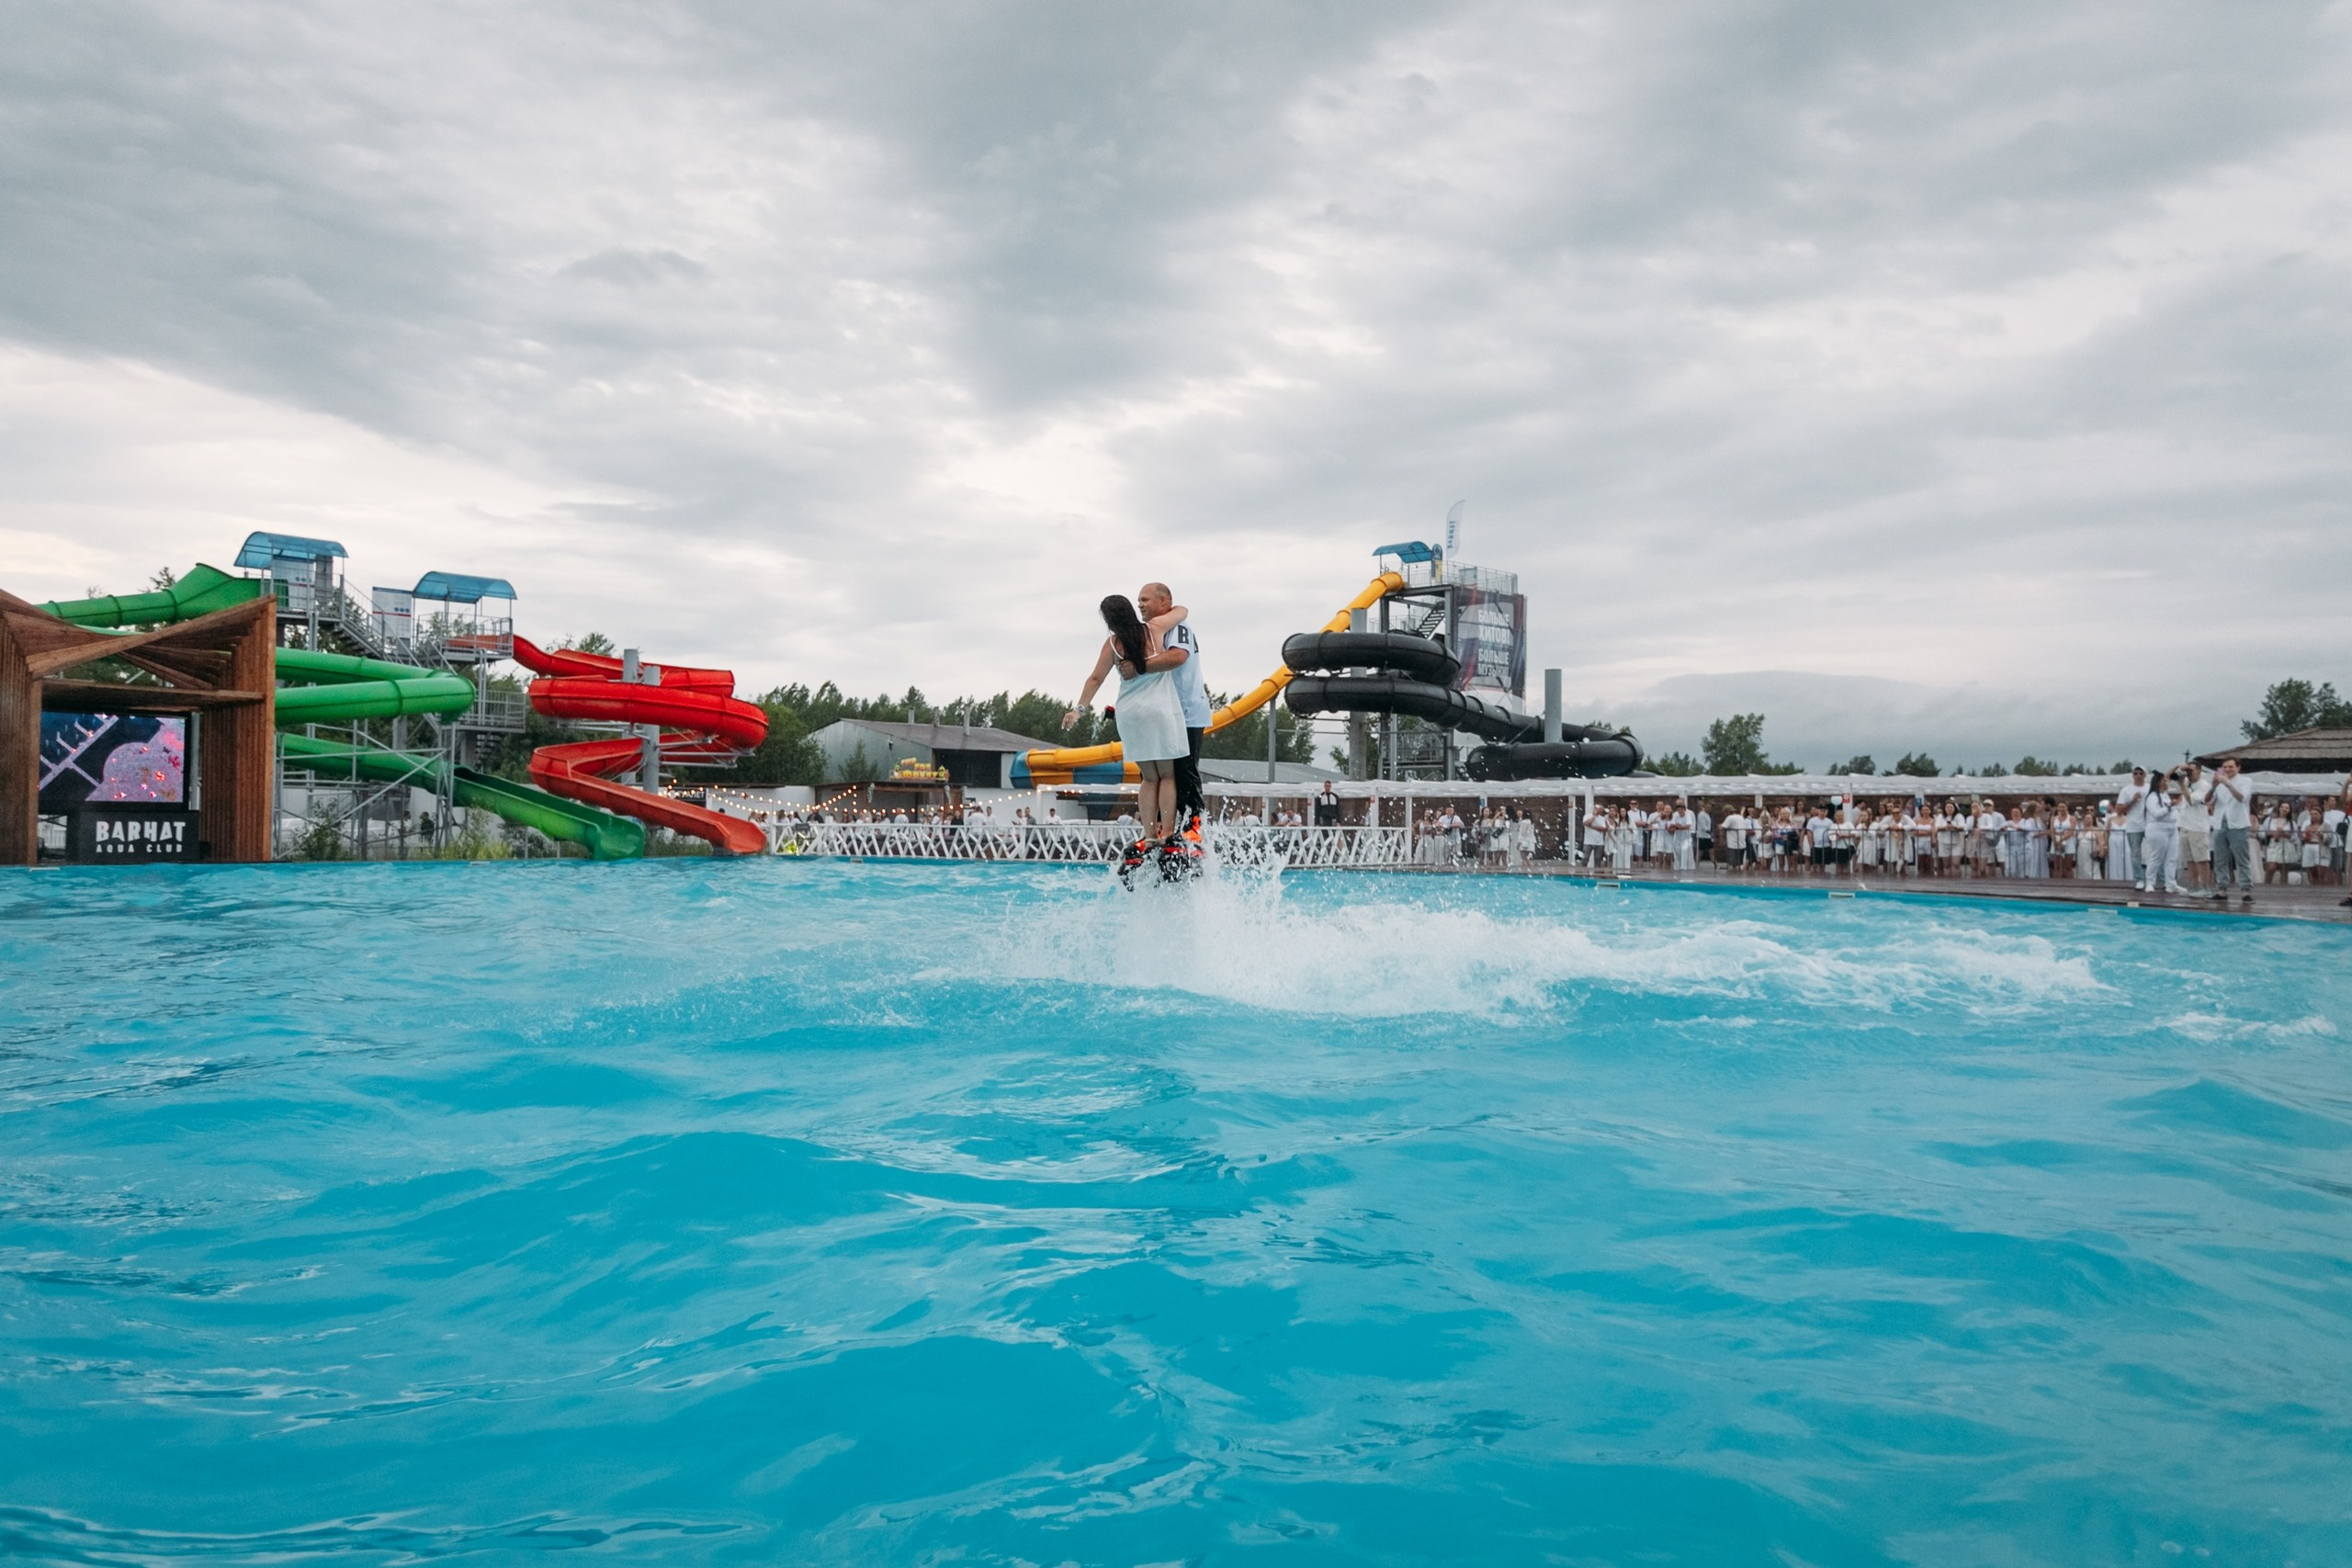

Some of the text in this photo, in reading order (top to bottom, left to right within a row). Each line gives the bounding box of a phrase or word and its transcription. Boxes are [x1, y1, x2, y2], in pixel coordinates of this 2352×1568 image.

[1478, 610, 1510, 626] БОЛЬШЕ
[1478, 626, 1510, 644] ХИТОВ!
[1477, 649, 1510, 665] БОЛЬШЕ
[96, 821, 187, 842] BARHAT
[96, 844, 183, 853] AQUA CLUB
